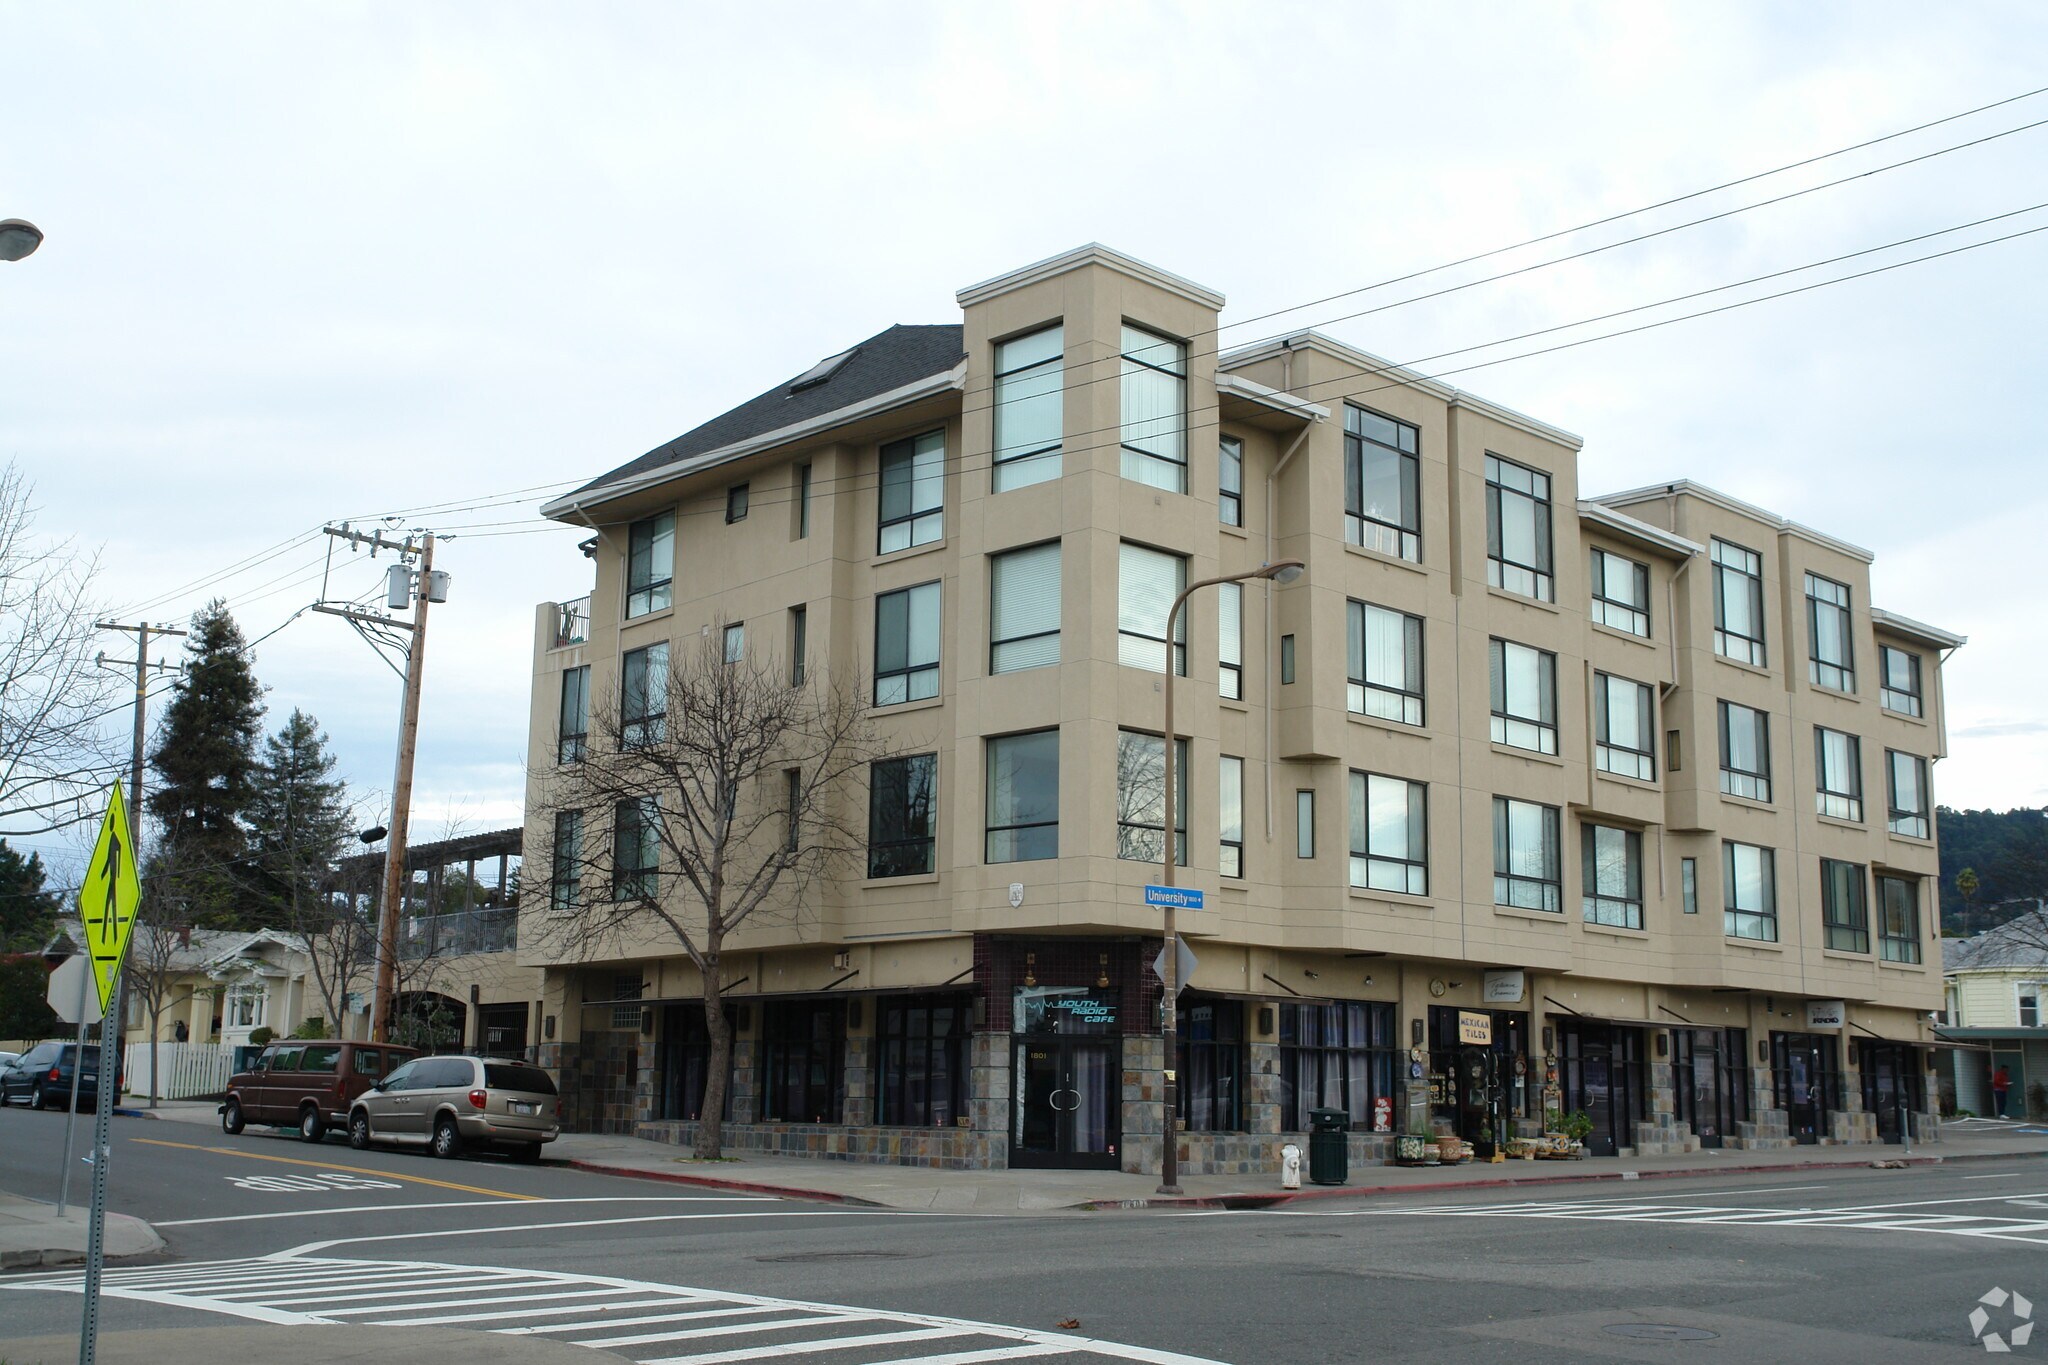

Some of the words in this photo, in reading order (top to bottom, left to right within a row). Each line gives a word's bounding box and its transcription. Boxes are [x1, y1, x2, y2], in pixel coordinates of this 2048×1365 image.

[1148, 889, 1188, 906] University
[1460, 1018, 1489, 1029] MEXICAN
[1465, 1029, 1486, 1039] TILES
